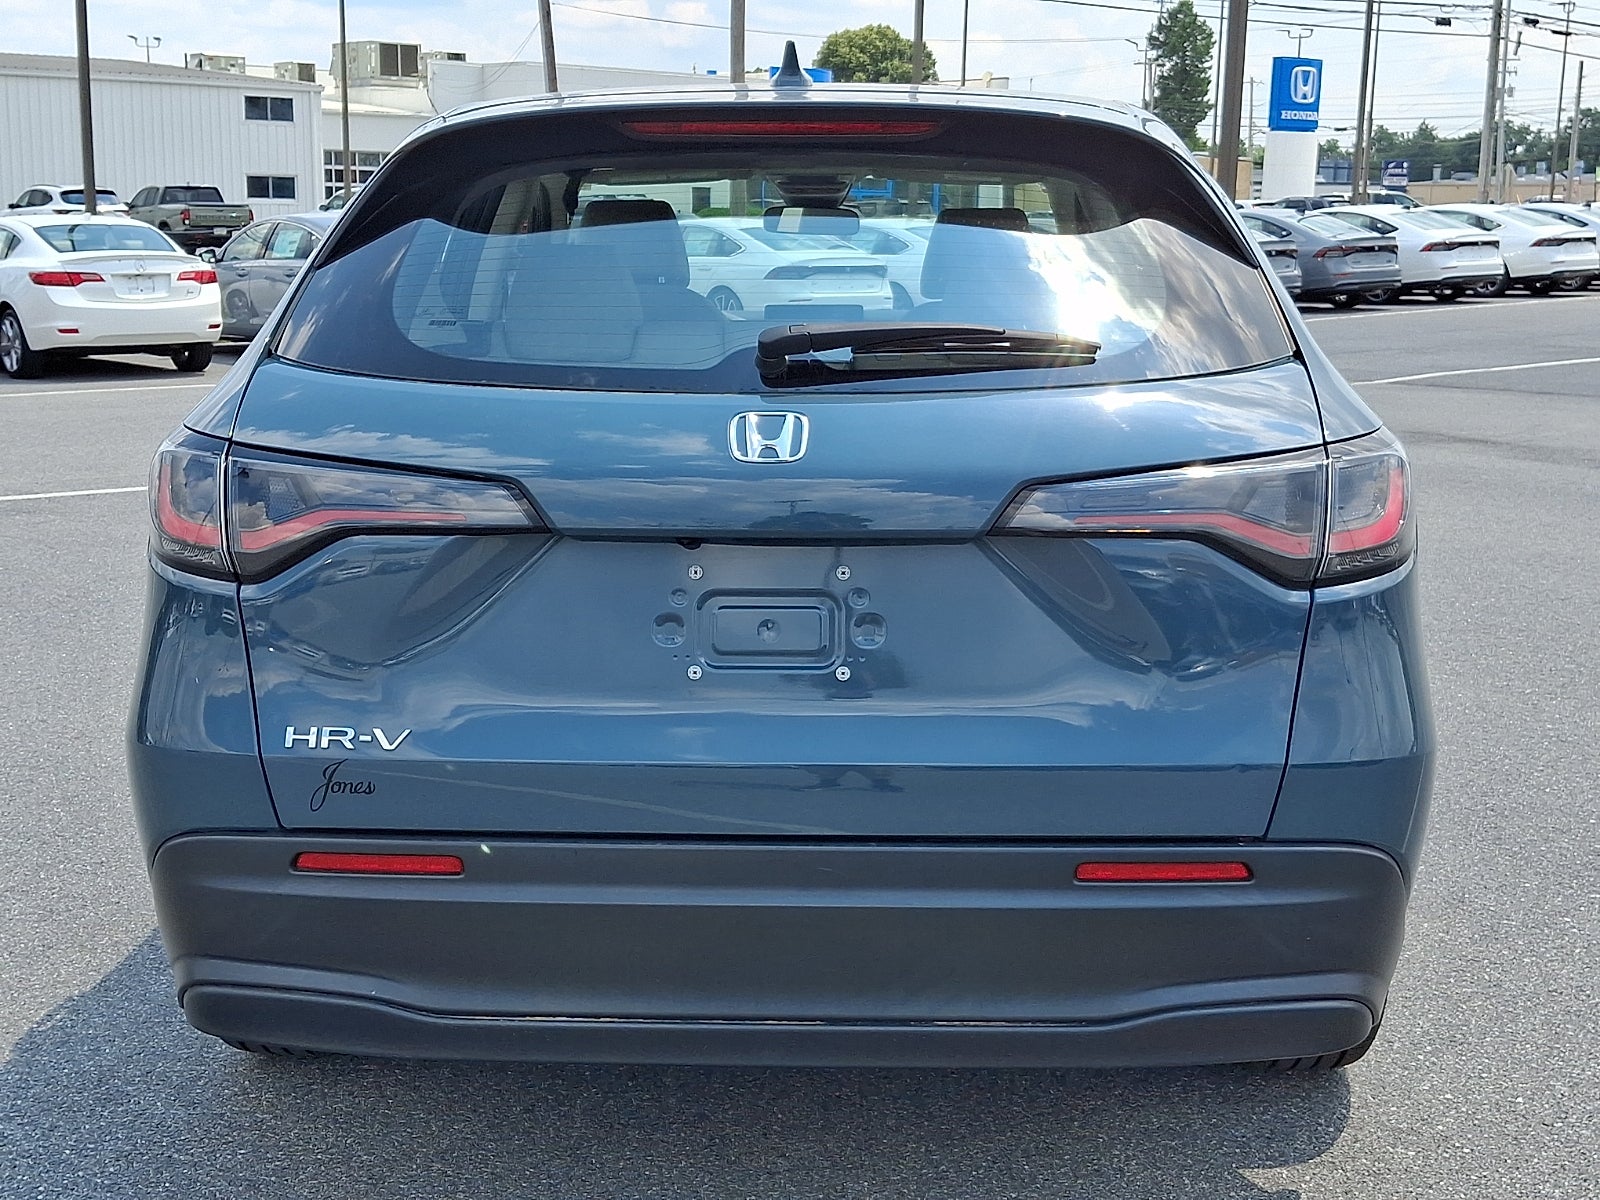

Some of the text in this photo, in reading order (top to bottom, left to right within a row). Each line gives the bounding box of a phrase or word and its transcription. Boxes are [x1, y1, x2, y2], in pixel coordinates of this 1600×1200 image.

[1280, 110, 1318, 120] HONDA
[284, 726, 412, 750] HR-V
[310, 758, 376, 812] Jones
